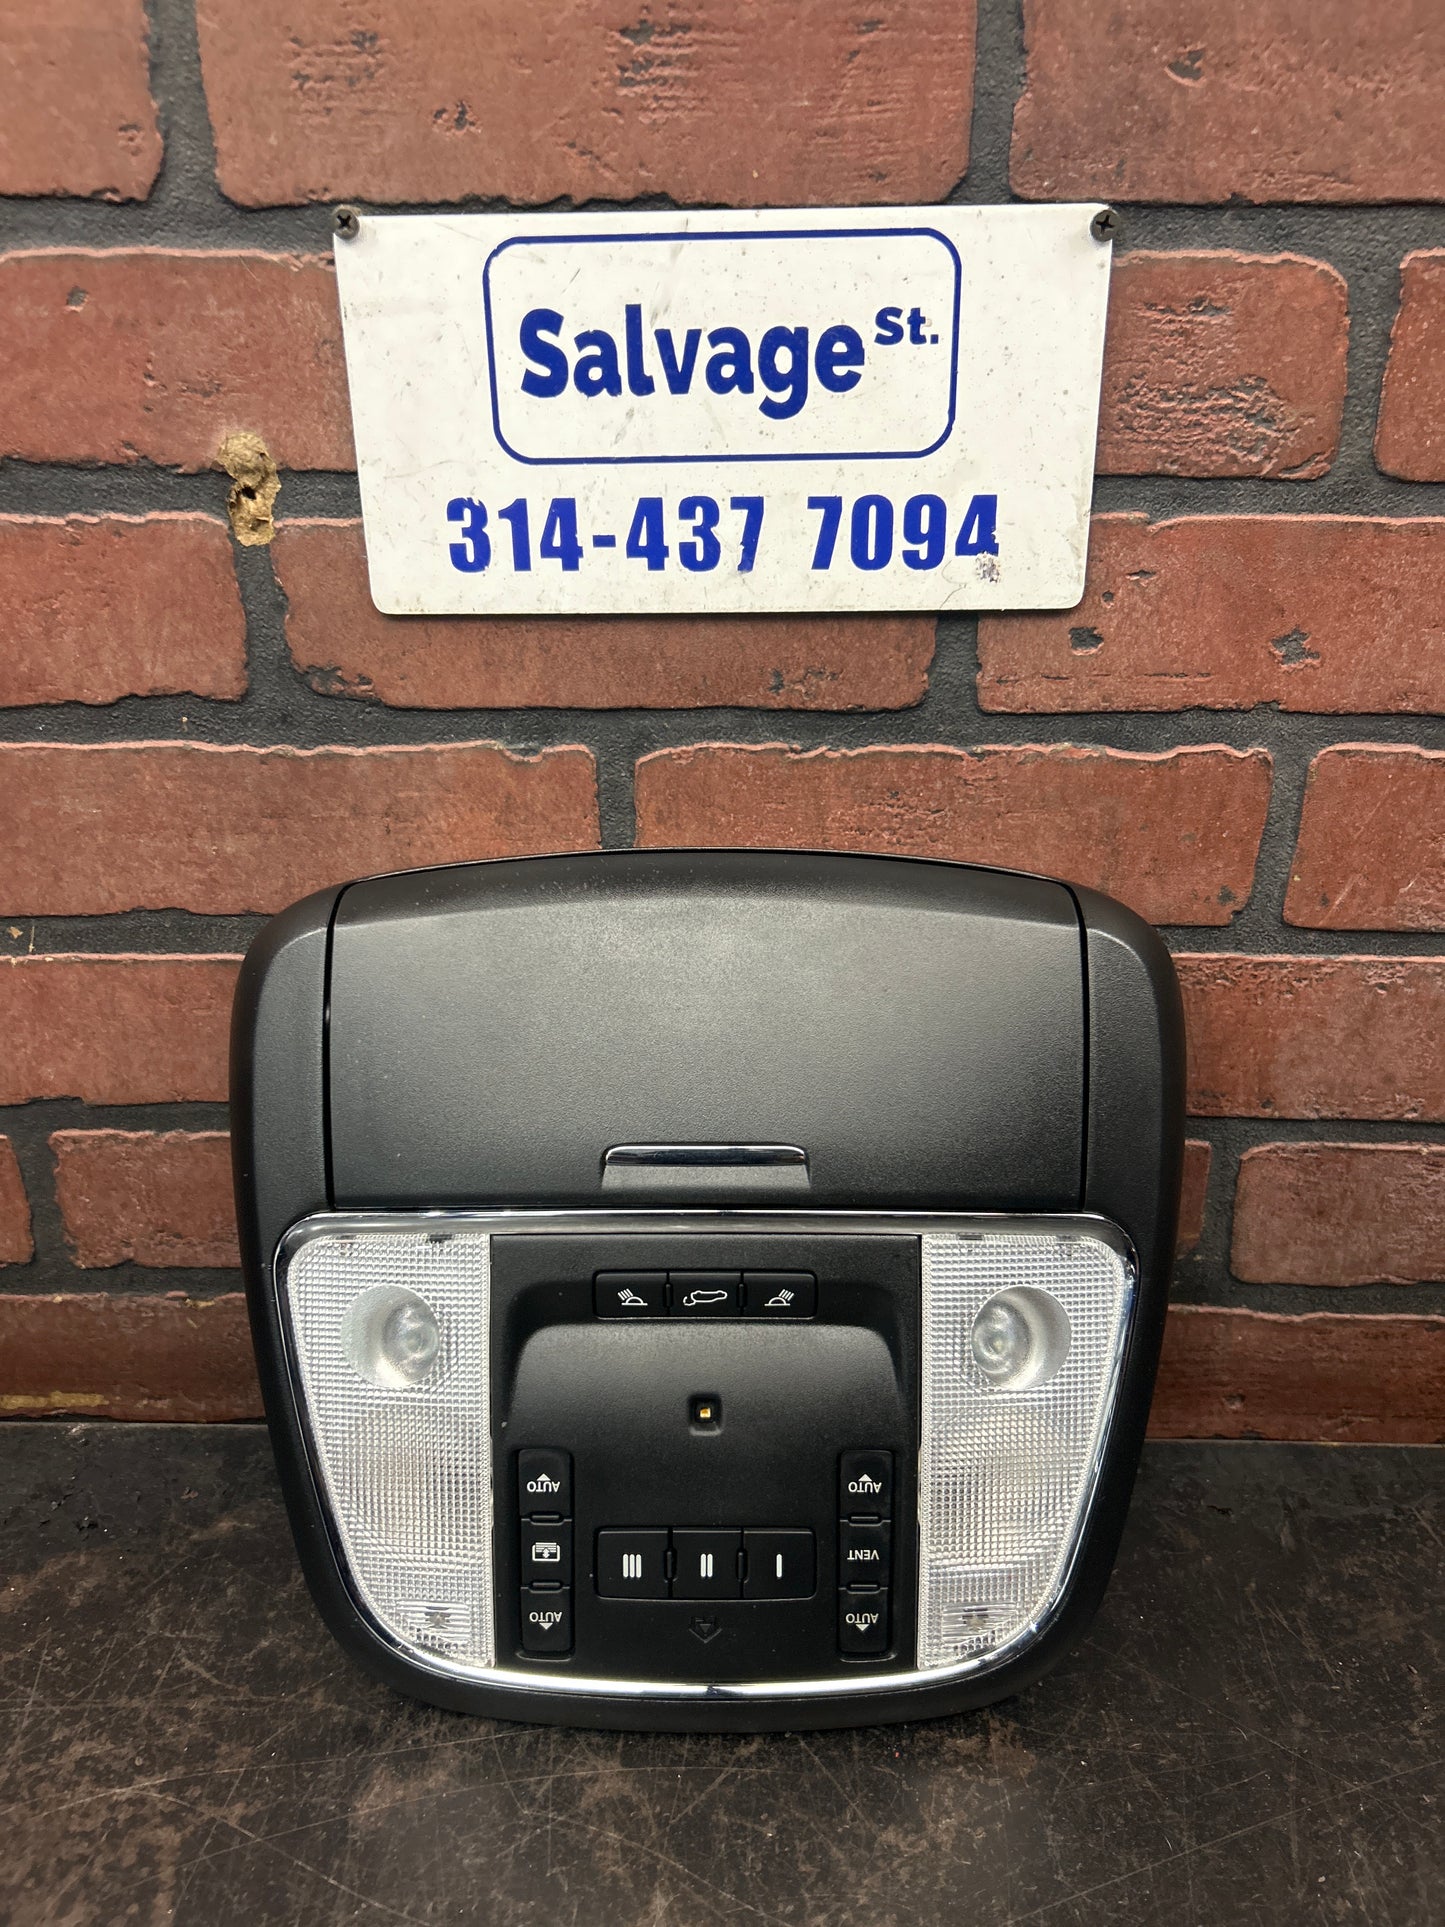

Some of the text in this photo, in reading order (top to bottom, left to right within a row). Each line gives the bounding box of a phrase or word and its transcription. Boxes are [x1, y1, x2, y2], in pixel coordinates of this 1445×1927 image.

[519, 304, 939, 420] Salvage St.
[446, 493, 999, 573] 314-437 7094
[526, 1480, 561, 1493] AUTO
[847, 1481, 883, 1494] AUTO
[846, 1549, 880, 1561] VENT
[529, 1611, 563, 1623] AUTO
[845, 1612, 879, 1624] AUTO
